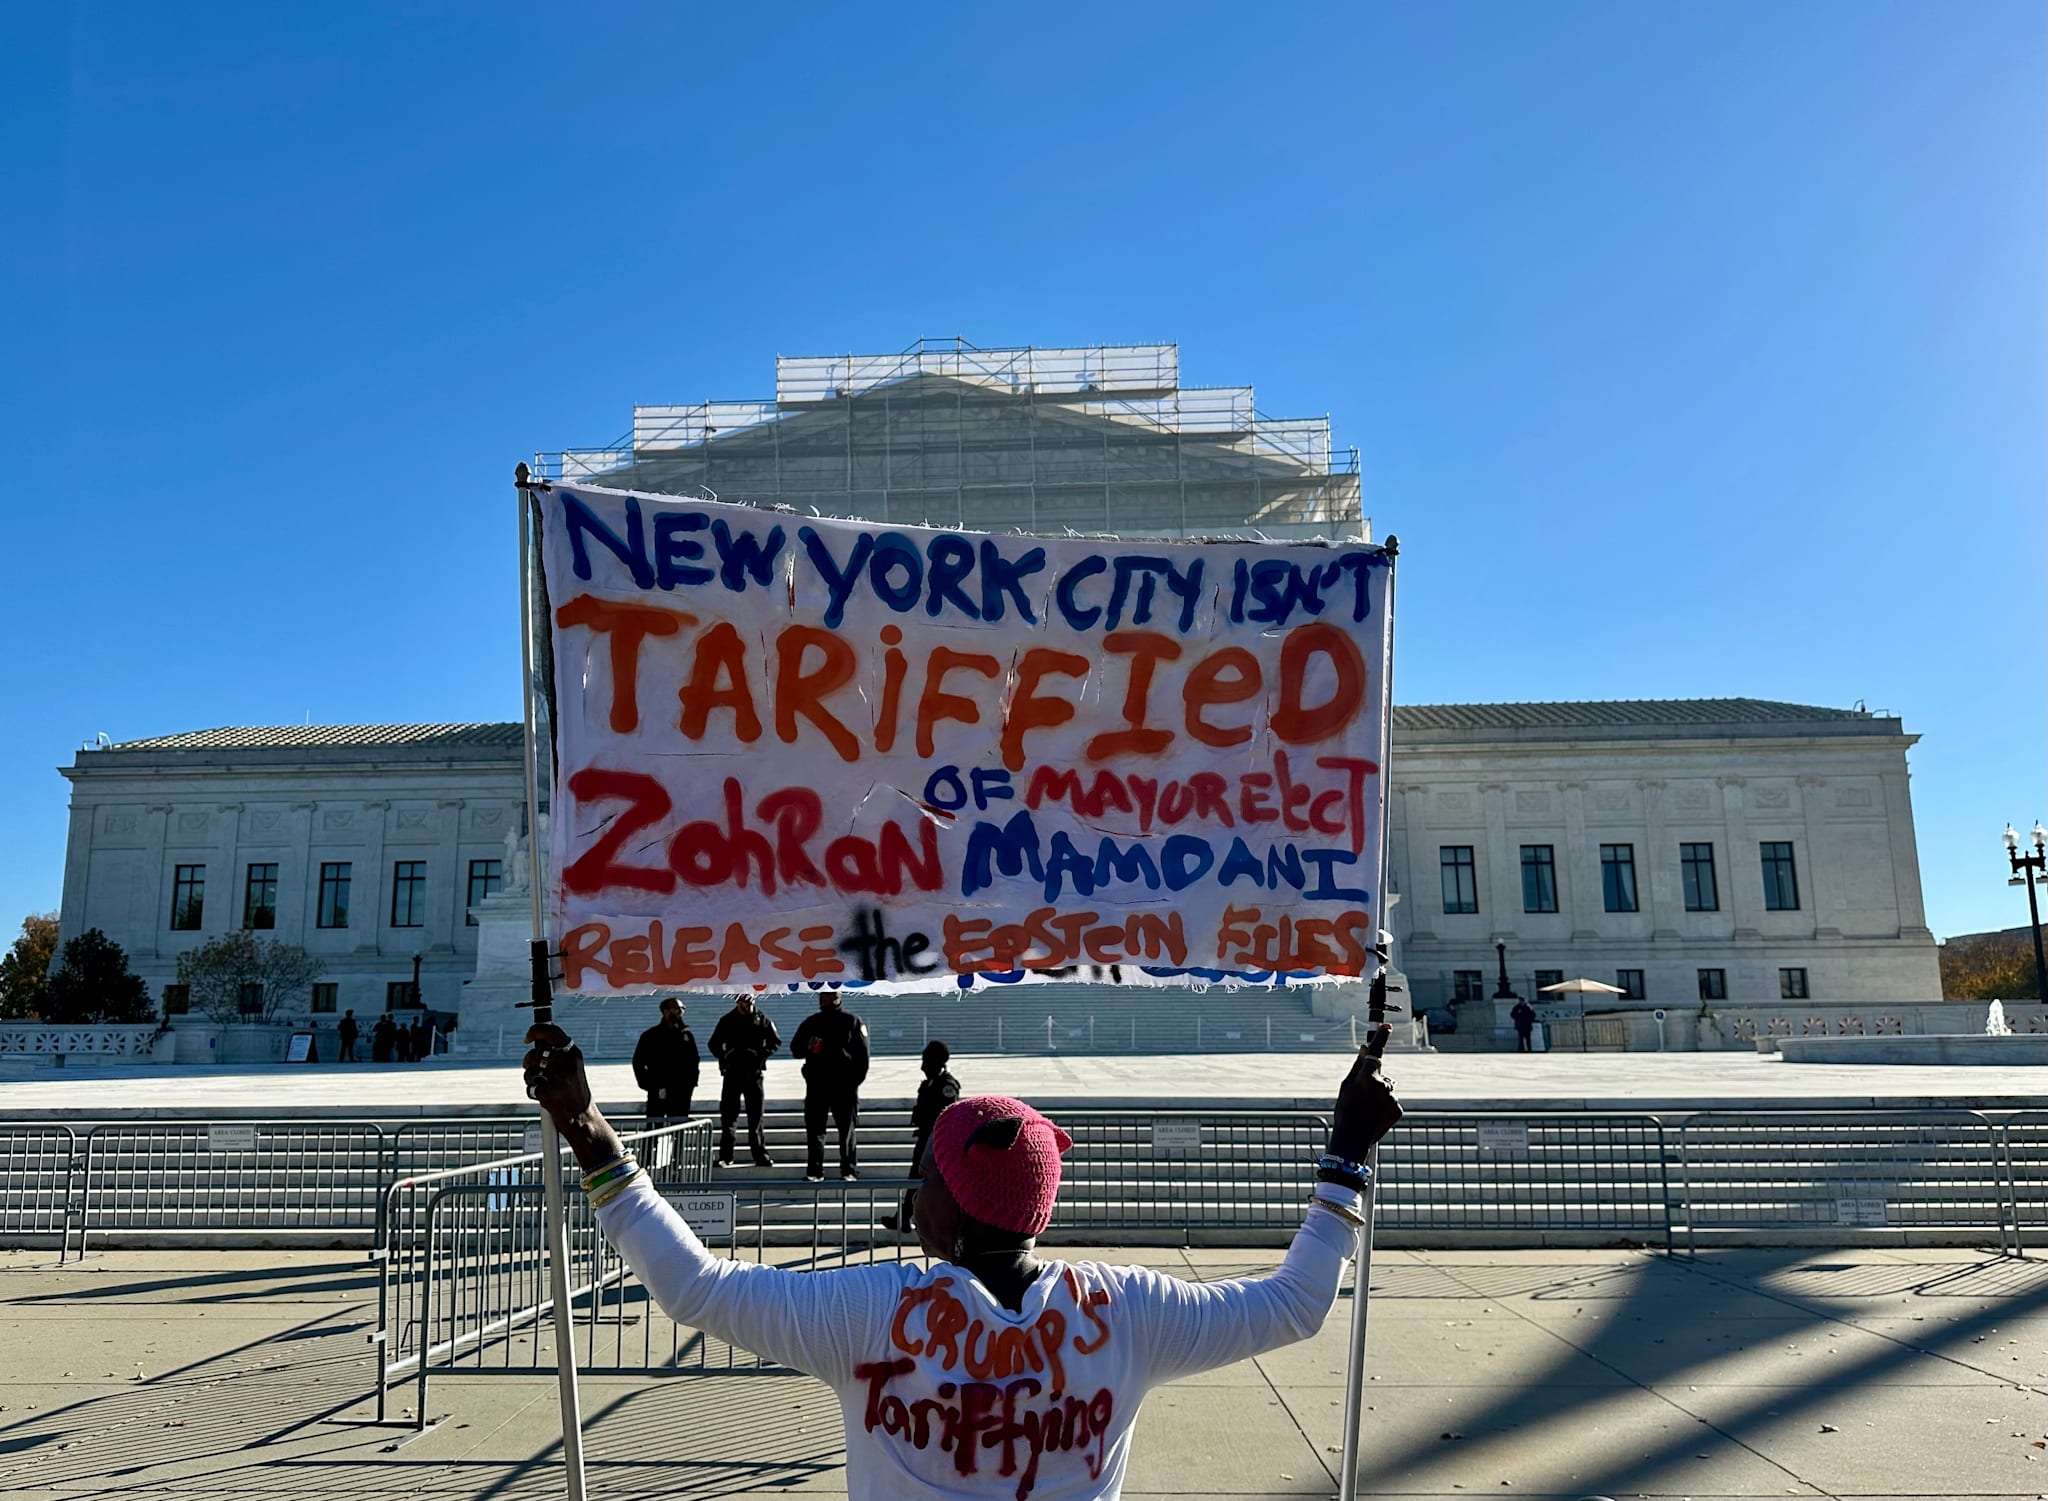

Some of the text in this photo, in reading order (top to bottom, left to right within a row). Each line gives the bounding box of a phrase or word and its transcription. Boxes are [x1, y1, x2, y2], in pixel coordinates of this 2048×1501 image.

[560, 492, 1390, 632] NEW YORK CITY ISN'T
[924, 765, 1015, 810] OF
[962, 810, 1369, 903] MAMDANI
[840, 908, 938, 980] the
[688, 1201, 724, 1211] CLOSED
